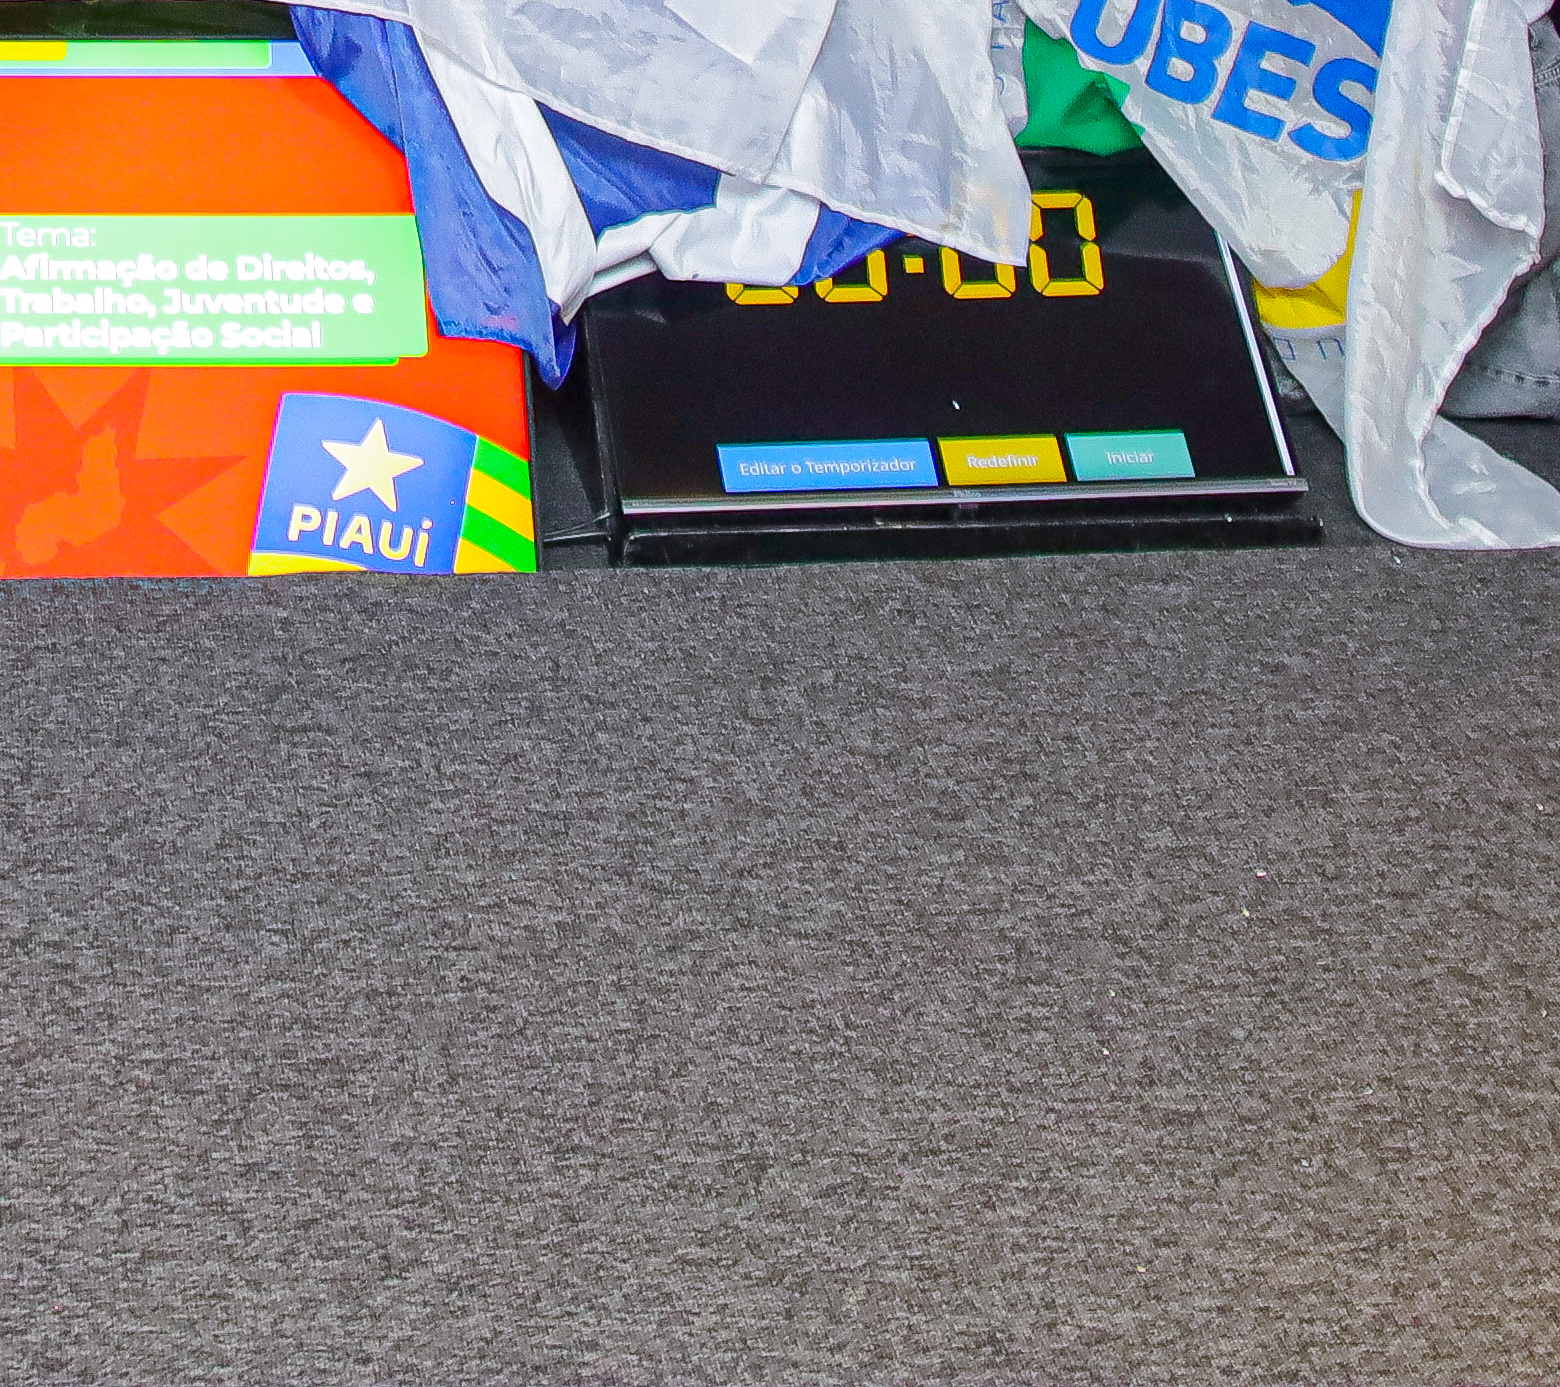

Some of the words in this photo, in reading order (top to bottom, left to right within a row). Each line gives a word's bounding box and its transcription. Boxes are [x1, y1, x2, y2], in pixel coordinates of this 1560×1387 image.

[0, 221, 97, 248] Tema:
[0, 251, 179, 289] Afirmação
[184, 253, 230, 281] de
[236, 251, 378, 286] Direitos,
[162, 287, 347, 315] Juventude
[352, 293, 376, 315] e
[0, 317, 215, 355] Participação
[219, 318, 323, 348] Social
[739, 459, 787, 476] Editar
[791, 463, 803, 475] o
[805, 455, 917, 477] Temporizador
[966, 454, 1040, 469] Redefinir
[1105, 449, 1155, 465] Iniciar
